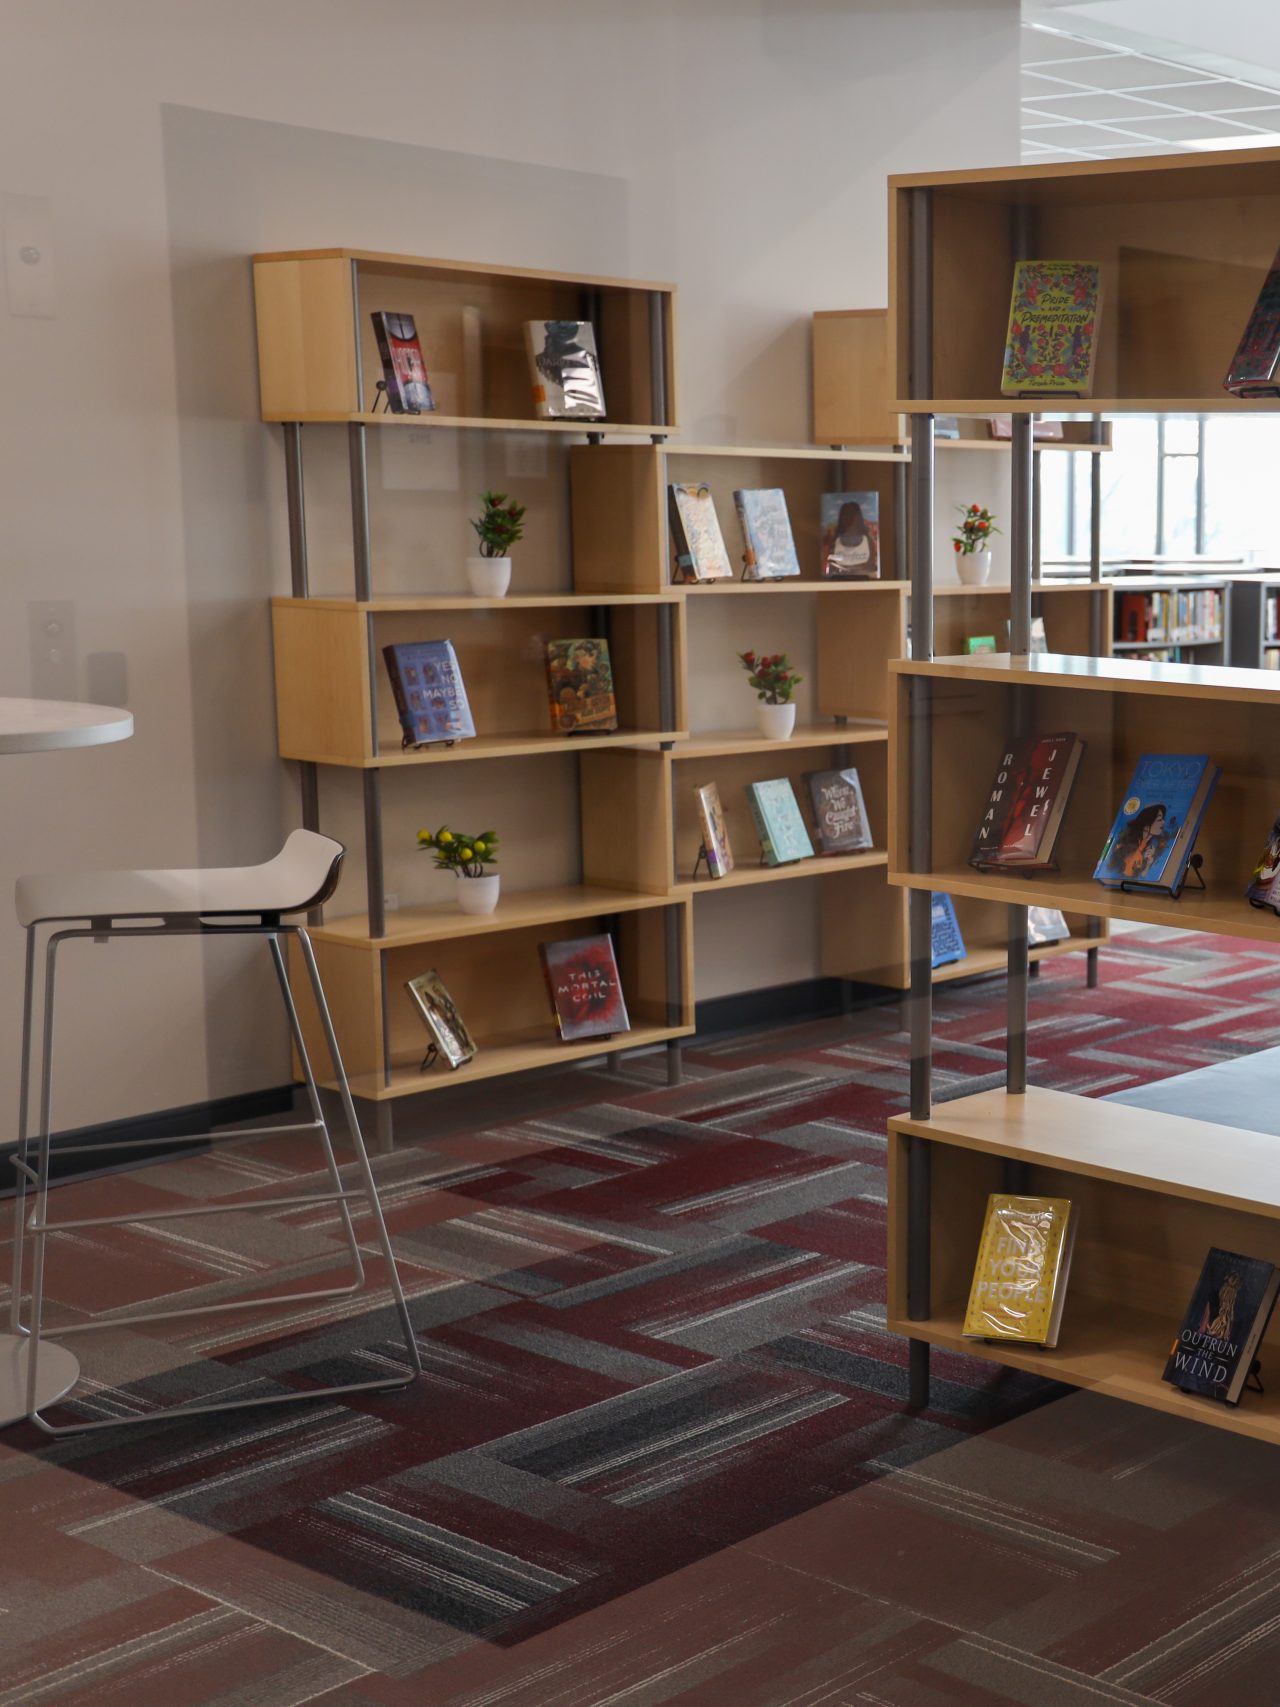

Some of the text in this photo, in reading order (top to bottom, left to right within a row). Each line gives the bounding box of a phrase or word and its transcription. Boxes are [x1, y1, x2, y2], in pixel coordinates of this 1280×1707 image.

[1041, 293, 1071, 305] PRIDE
[1021, 312, 1089, 325] PREMEDITATION
[432, 660, 457, 672] YES
[440, 674, 458, 685] NO
[422, 687, 463, 700] MAYBE
[448, 699, 465, 710] SO
[1141, 760, 1202, 780] TOKYO
[568, 969, 601, 981] THIS
[558, 980, 617, 994] MORTAL
[572, 992, 607, 1003] COIL
[976, 1280, 1047, 1303] PEOPLE
[1181, 1329, 1238, 1358] OUTRUN
[1198, 1347, 1213, 1360] THE
[1174, 1351, 1228, 1384] WIND
